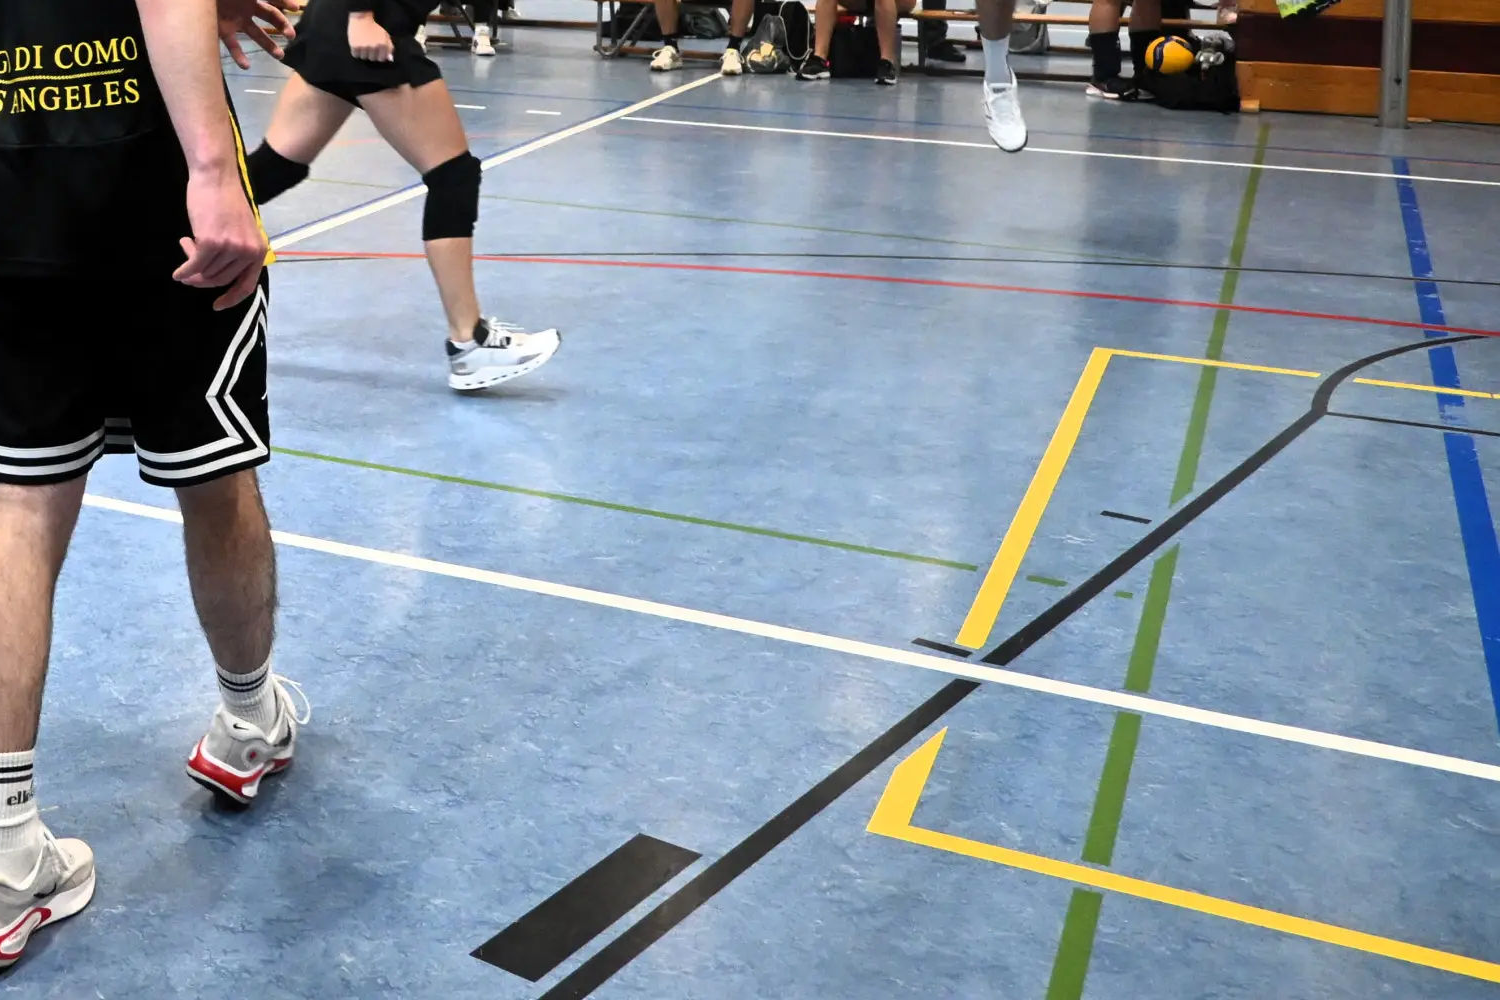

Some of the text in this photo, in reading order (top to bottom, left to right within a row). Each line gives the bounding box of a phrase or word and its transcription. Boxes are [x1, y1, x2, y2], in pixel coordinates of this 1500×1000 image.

[15, 45, 44, 72] DI
[54, 36, 138, 70] COMO
[11, 78, 141, 115] ANGELES
